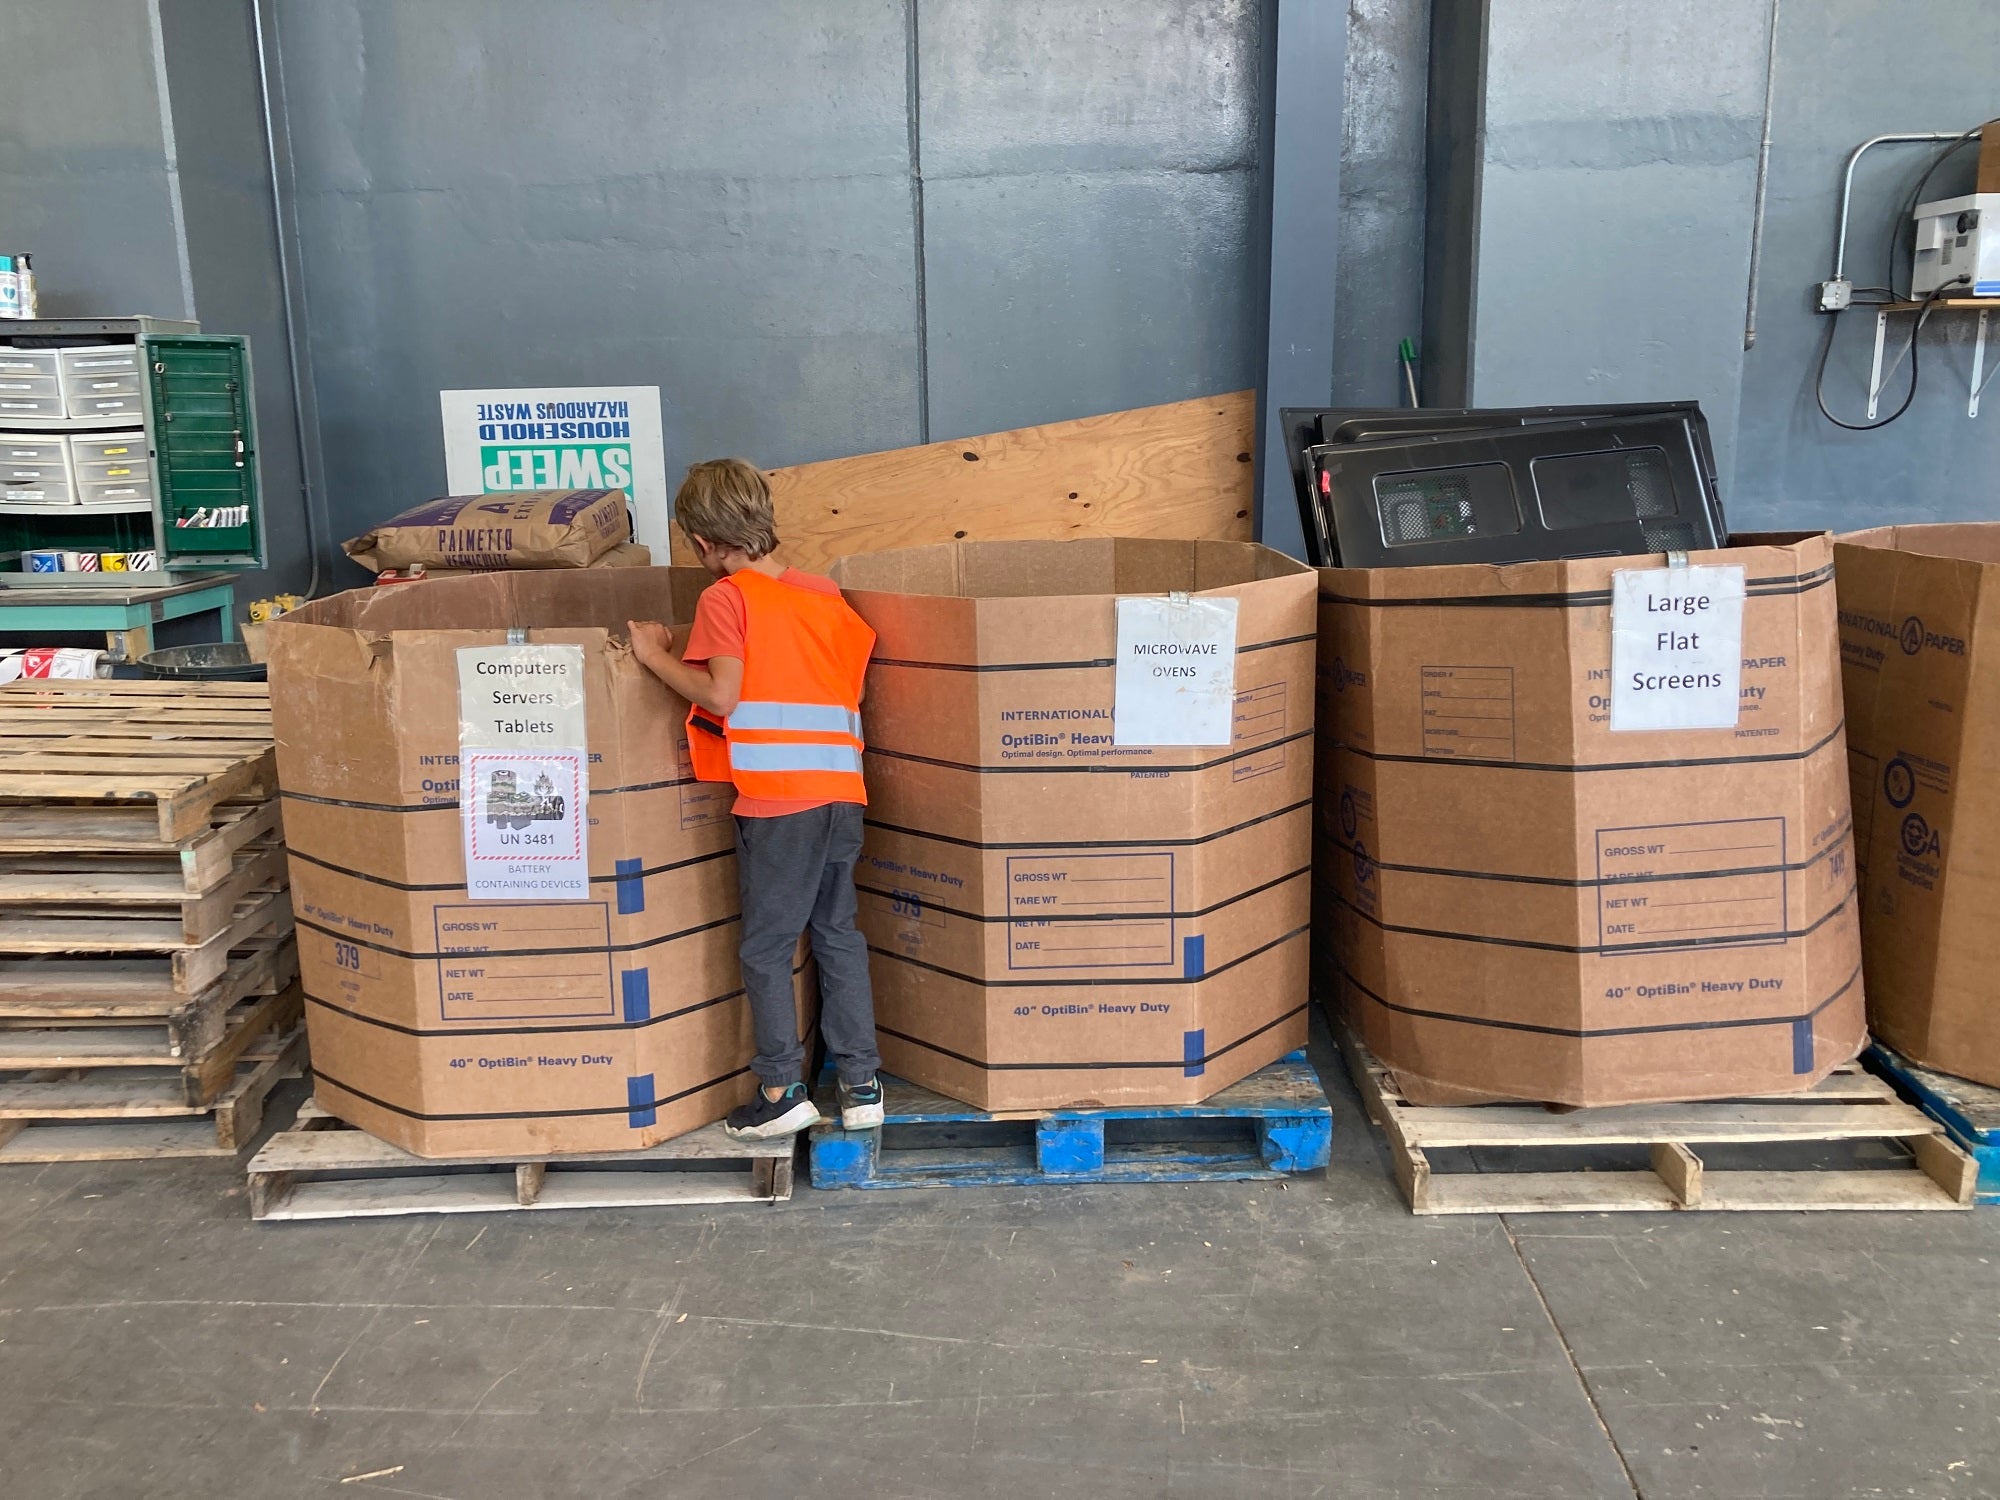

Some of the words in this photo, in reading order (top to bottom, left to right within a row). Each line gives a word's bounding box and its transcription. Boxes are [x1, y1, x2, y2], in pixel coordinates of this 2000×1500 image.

[477, 404, 531, 420] WASTE
[538, 402, 628, 419] HAZARDOUS
[479, 421, 630, 441] HOUSEHOLD
[484, 448, 631, 490] SWEEP
[438, 528, 513, 552] PALMETTO
[1647, 594, 1710, 615] Large
[1657, 631, 1700, 651] Flat
[1925, 632, 1965, 656] PAPER
[1133, 643, 1217, 656] MICROWAVE
[476, 661, 567, 677] Computers
[1741, 656, 1786, 670] PAPER
[1152, 666, 1196, 678] OVENS
[1632, 672, 1722, 691] Screens
[492, 690, 553, 705] Servers
[1001, 709, 1109, 722] INTERNATIONAL
[494, 719, 554, 734] Tablets
[1735, 727, 1780, 738] PATENTED
[1001, 732, 1066, 748] OptiBin®
[1001, 750, 1034, 760] Optimal
[1036, 750, 1065, 760] design.
[1067, 749, 1099, 758] Optimal
[1101, 748, 1155, 758] performance.
[1130, 771, 1170, 779] PATENTED
[500, 834, 520, 846] UN
[524, 834, 555, 846] 3481
[1604, 845, 1645, 857] GROSS
[1647, 845, 1665, 854] WT
[508, 864, 551, 874] BATTERY
[909, 866, 938, 882] Heavy
[940, 873, 964, 888] Duty
[1014, 873, 1050, 882] GROSS
[1052, 872, 1068, 881] WT
[475, 879, 538, 890] CONTAINING
[541, 879, 581, 890] DEVICES
[1014, 896, 1040, 905] TARE
[1042, 895, 1058, 905] WT
[1606, 898, 1628, 909] NET
[1631, 897, 1649, 907] WT
[373, 923, 394, 939] Duty
[442, 922, 480, 932] GROSS
[482, 922, 499, 931] WT
[1607, 924, 1635, 934] DATE
[1015, 941, 1040, 951] DATE
[335, 942, 360, 970] 379
[446, 969, 466, 978] NET
[468, 968, 486, 978] WT
[1637, 981, 1696, 998] OptiBin®
[1701, 980, 1744, 994] Heavy
[1749, 977, 1783, 991] Duty
[447, 992, 474, 1001] DATE
[1041, 1003, 1094, 1017] OptiBin®
[1098, 1003, 1136, 1015] Heavy
[1140, 1001, 1170, 1014] Duty
[478, 1056, 533, 1069] OptiBin®
[537, 1056, 577, 1068] Heavy
[581, 1054, 614, 1067] Duty
